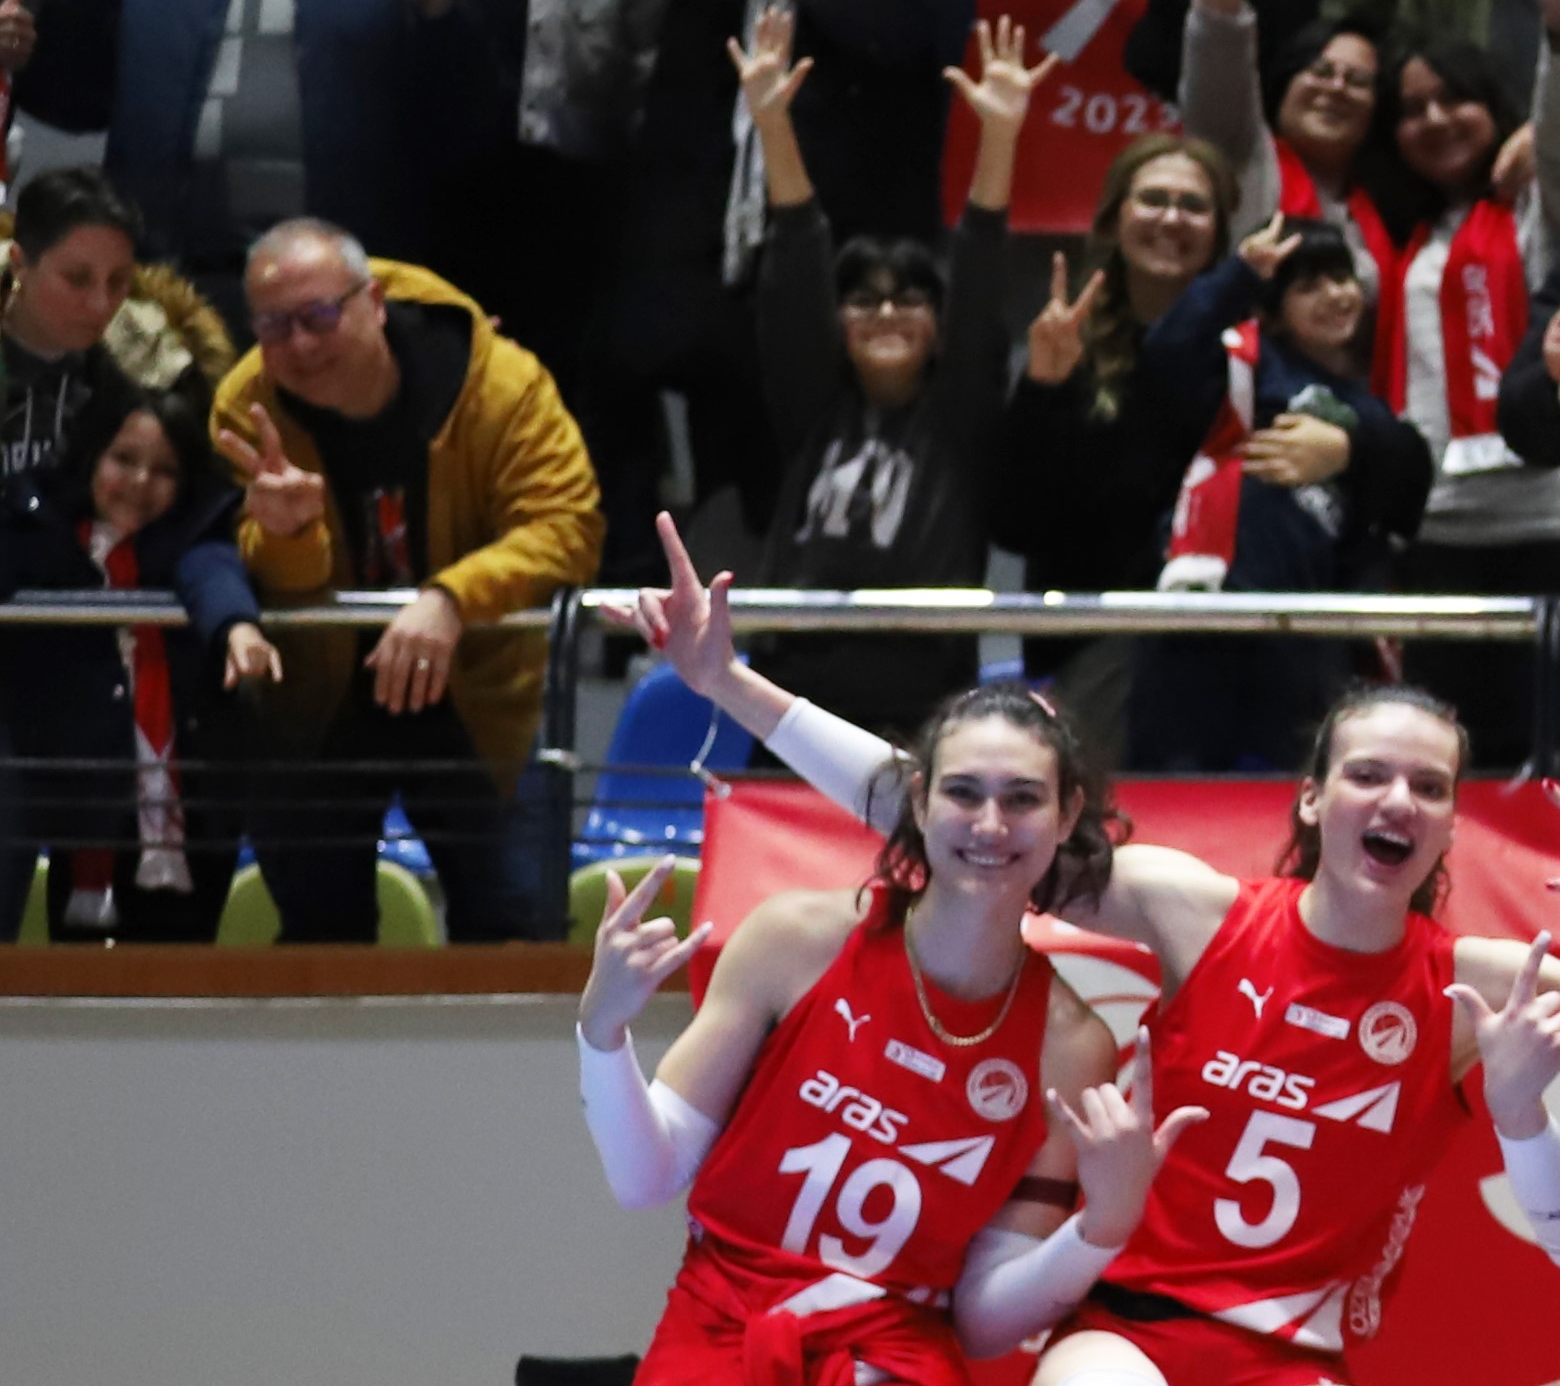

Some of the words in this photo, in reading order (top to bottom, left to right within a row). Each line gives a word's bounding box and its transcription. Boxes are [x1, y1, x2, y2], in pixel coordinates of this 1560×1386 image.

[800, 1070, 907, 1144] aras
[1202, 1050, 1315, 1110] aras
[779, 1132, 922, 1288] 19
[1214, 1110, 1316, 1248] 5
